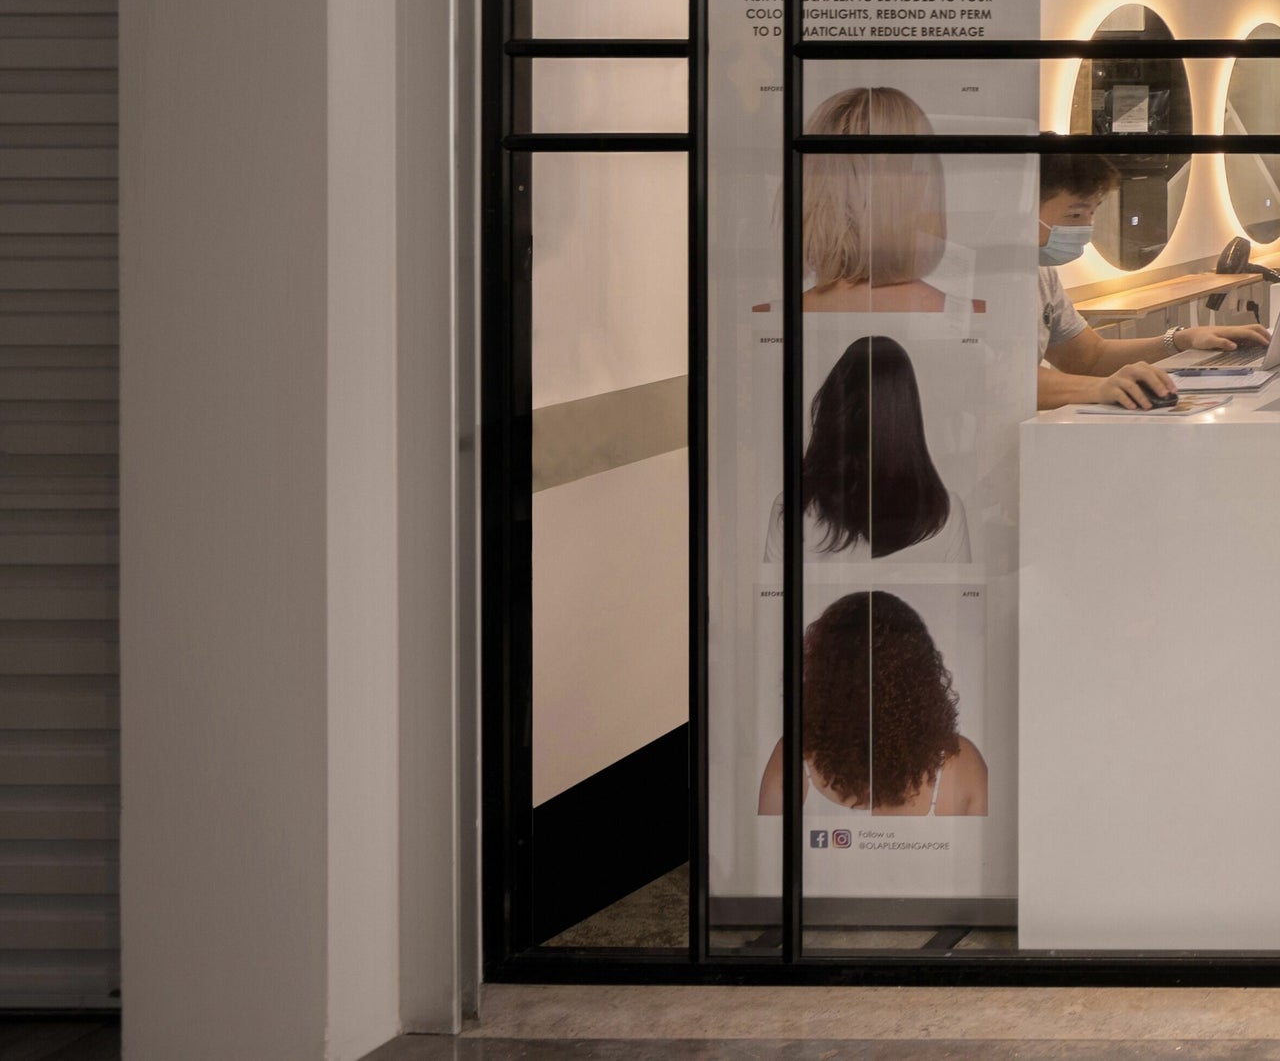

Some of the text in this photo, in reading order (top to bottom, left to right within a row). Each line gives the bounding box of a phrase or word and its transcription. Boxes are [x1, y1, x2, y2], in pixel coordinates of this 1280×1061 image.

[799, 8, 873, 21] IGHLIGHTS,
[877, 8, 926, 19] REBOND
[930, 8, 957, 19] AND
[960, 8, 992, 19] PERM
[753, 26, 985, 36] TO DMATICALLY REDUCE BREAKAGE
[858, 830, 885, 839] Follow
